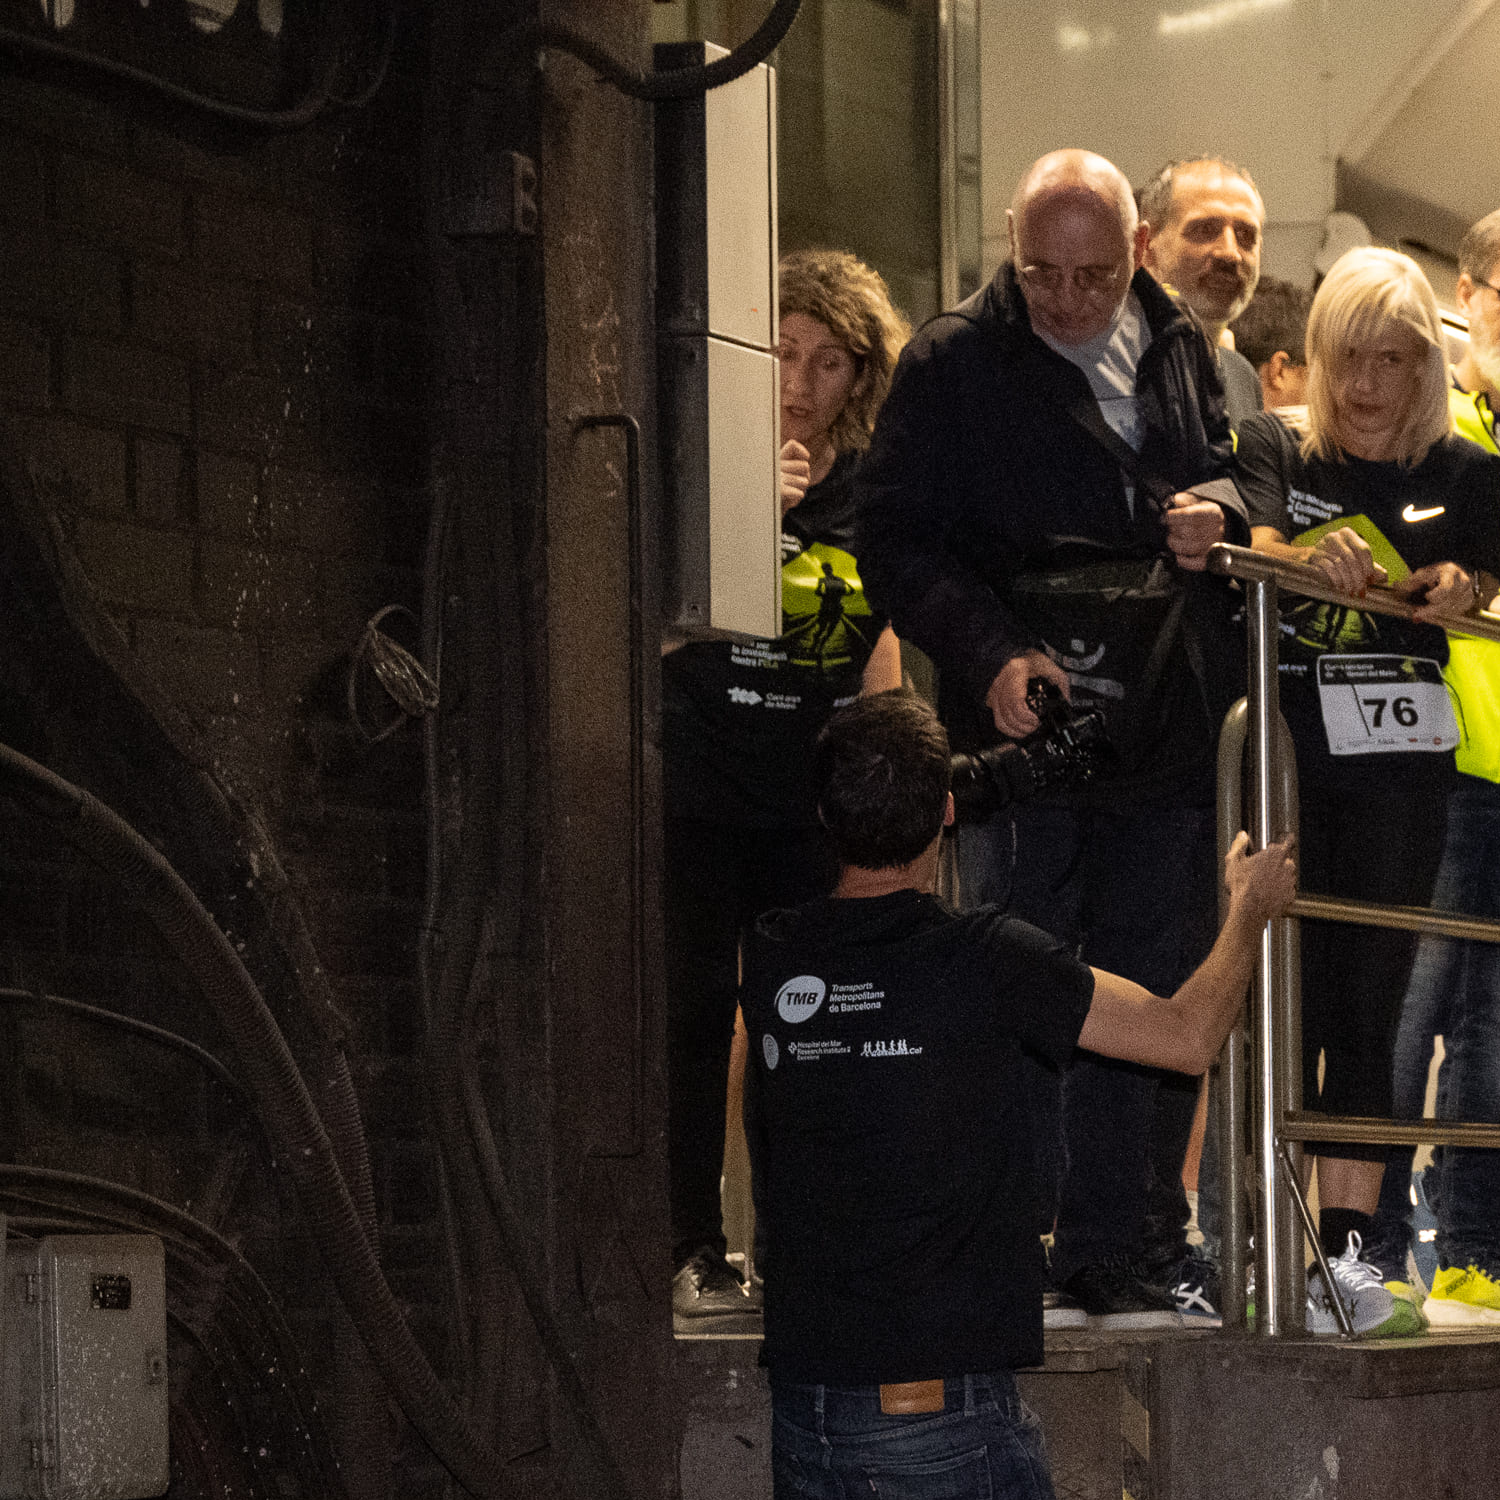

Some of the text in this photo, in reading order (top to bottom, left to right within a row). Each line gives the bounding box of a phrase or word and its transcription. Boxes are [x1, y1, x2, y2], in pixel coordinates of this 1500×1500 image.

[1363, 697, 1419, 728] 76
[832, 982, 873, 993] Transports
[786, 992, 818, 1006] TMB
[829, 990, 885, 1002] Metropolitans
[829, 1001, 881, 1013] de Barcelona
